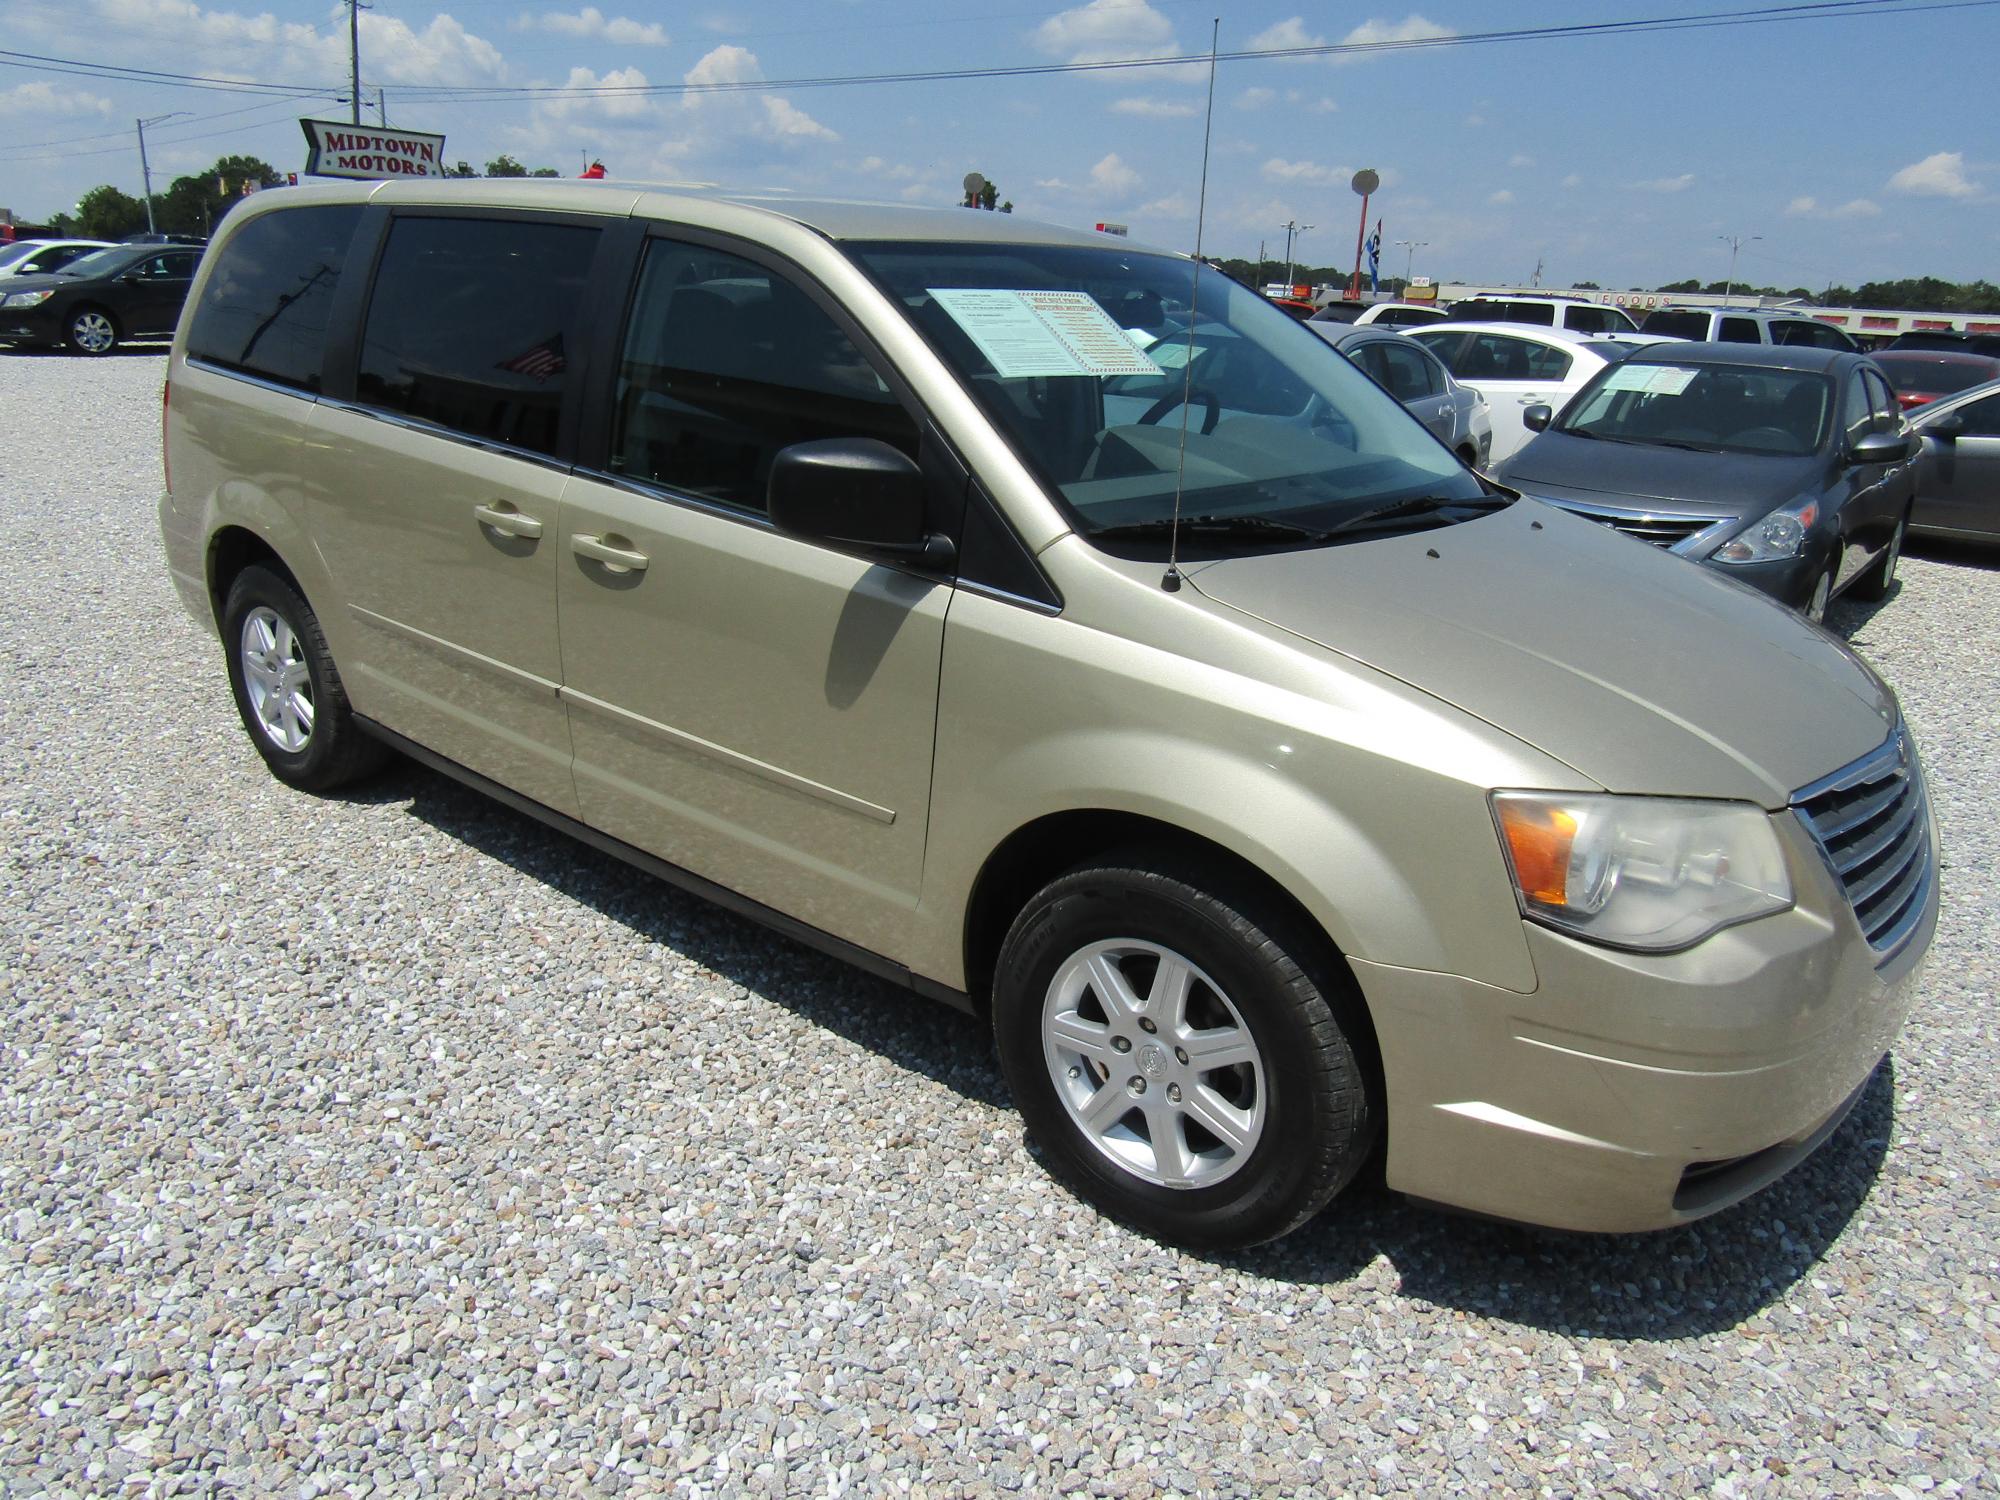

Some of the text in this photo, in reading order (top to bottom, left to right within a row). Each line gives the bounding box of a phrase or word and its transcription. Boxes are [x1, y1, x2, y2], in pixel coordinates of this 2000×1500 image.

[325, 131, 434, 163] MIDTOWN
[338, 154, 428, 176] MOTORS
[1602, 294, 1671, 307] FOODS
